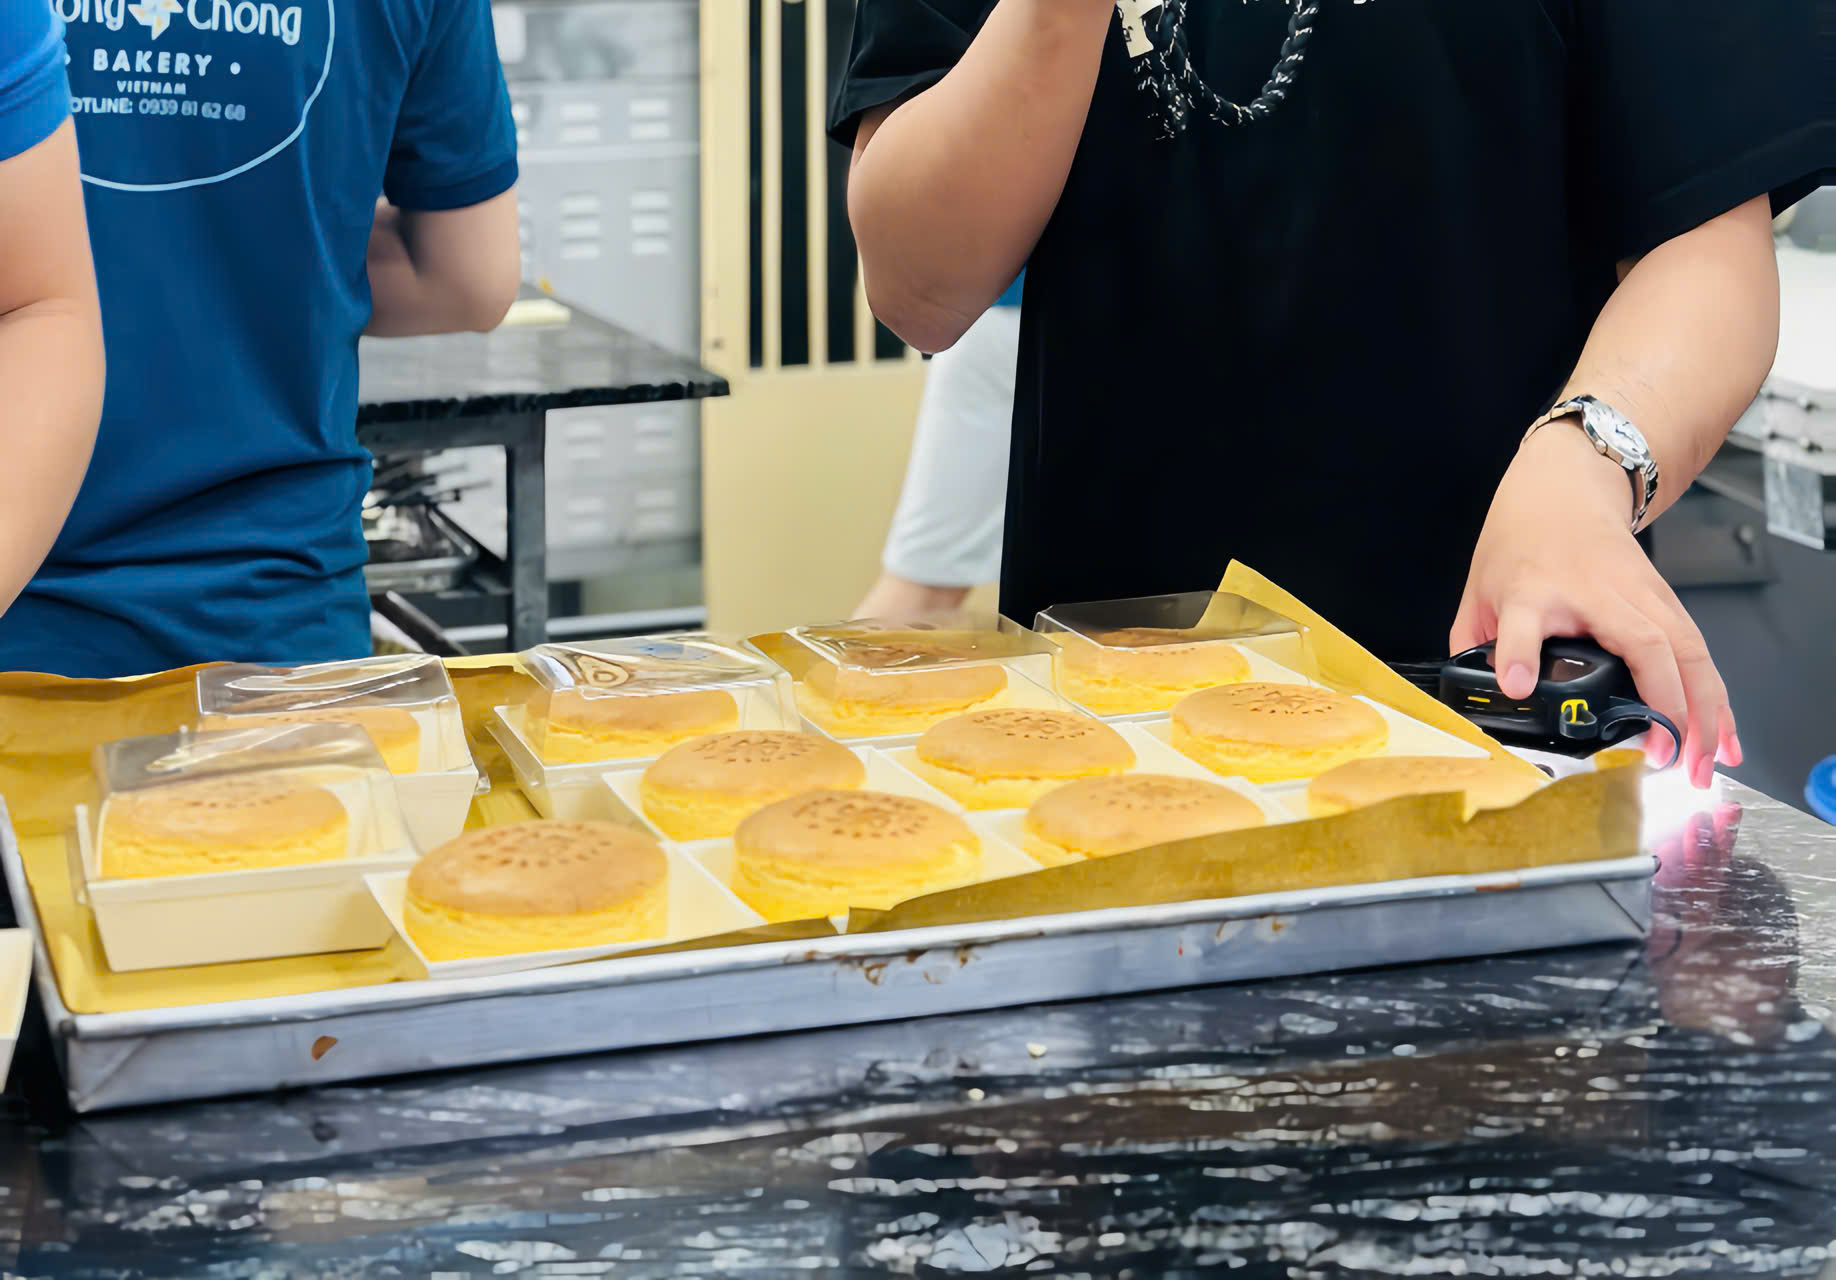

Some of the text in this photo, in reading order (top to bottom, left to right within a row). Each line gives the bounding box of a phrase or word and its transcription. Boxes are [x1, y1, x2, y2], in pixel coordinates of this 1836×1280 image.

[93, 48, 213, 77] BAKERY
[116, 80, 187, 96] VIETNAM
[71, 97, 134, 114] OTLINE:
